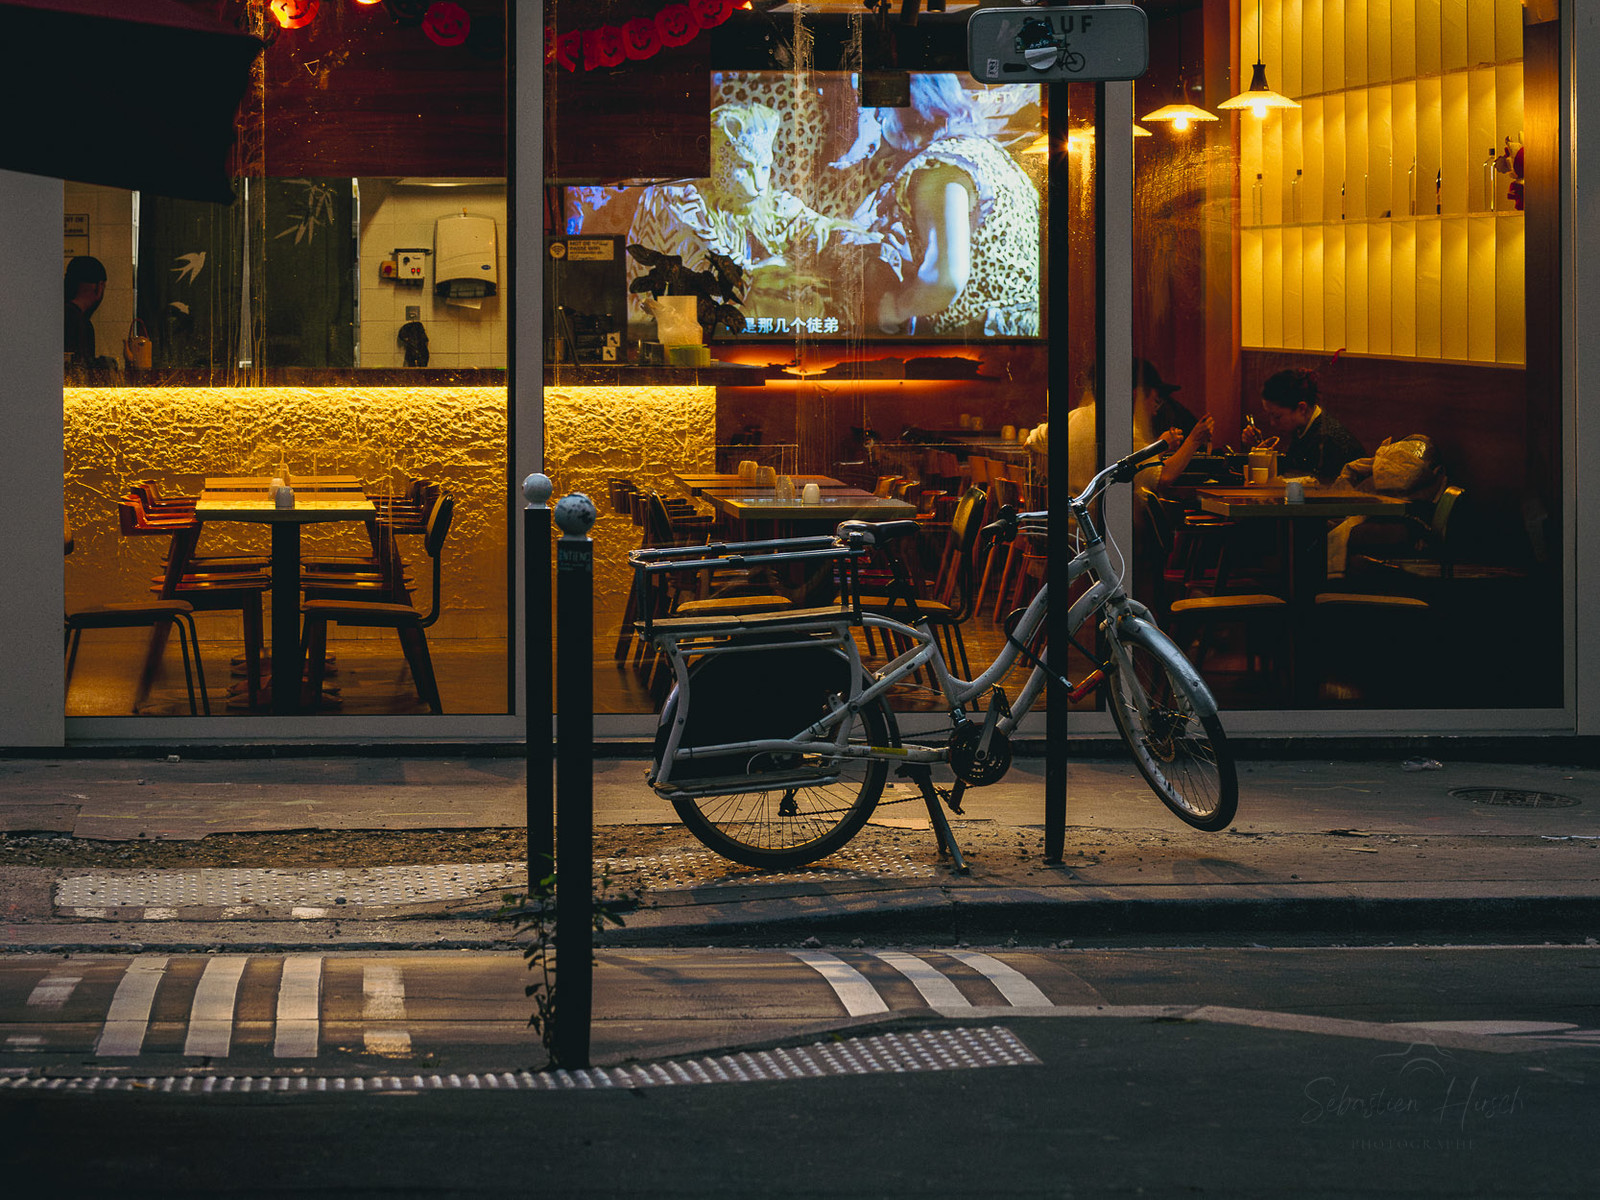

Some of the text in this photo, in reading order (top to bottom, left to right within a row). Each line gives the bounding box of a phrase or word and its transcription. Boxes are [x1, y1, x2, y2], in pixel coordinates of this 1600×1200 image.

[726, 316, 840, 334] 是那几个徒弟
